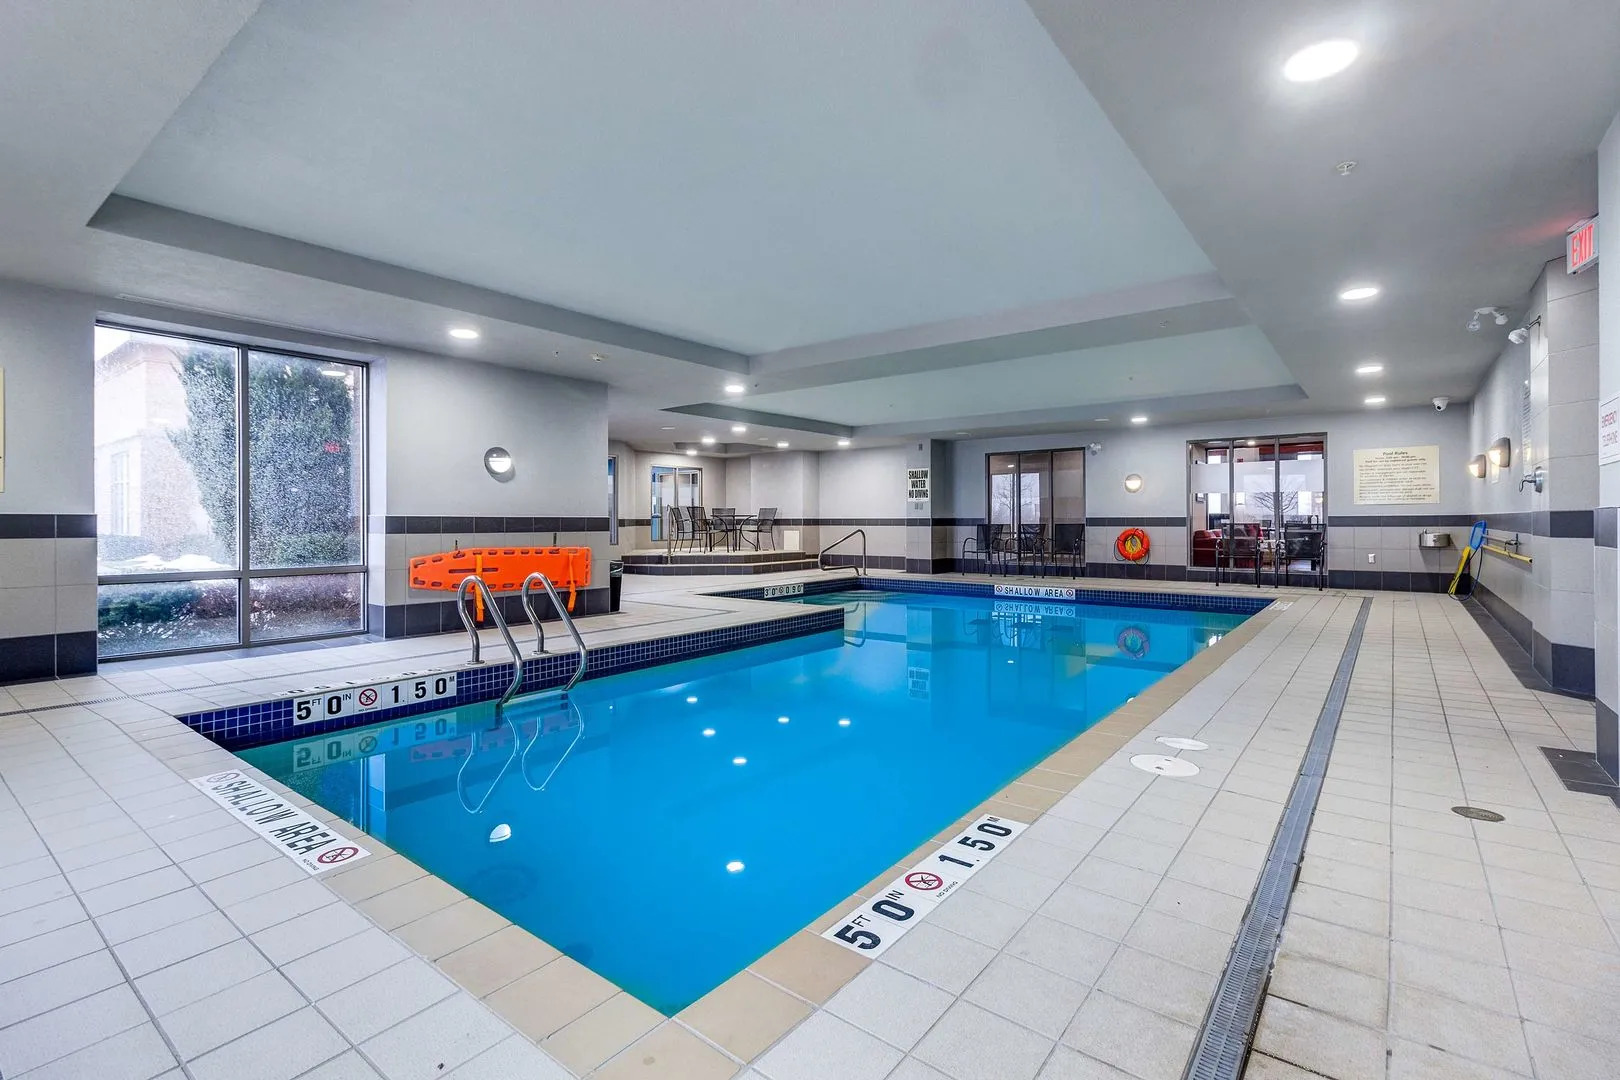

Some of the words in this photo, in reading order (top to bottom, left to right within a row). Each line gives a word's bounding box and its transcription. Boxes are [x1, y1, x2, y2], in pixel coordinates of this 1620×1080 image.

[1572, 224, 1595, 267] EXIT
[909, 470, 928, 479] SHALLOW
[911, 480, 926, 488] WATER
[909, 489, 914, 498] NO
[915, 489, 928, 498] DIVING
[1004, 586, 1041, 596] SHALLOW
[1044, 588, 1064, 598] AREA
[211, 780, 298, 825] SHALLOW
[269, 821, 337, 855] AREA
[936, 890, 946, 898] NO
[943, 880, 959, 893] DIVING
